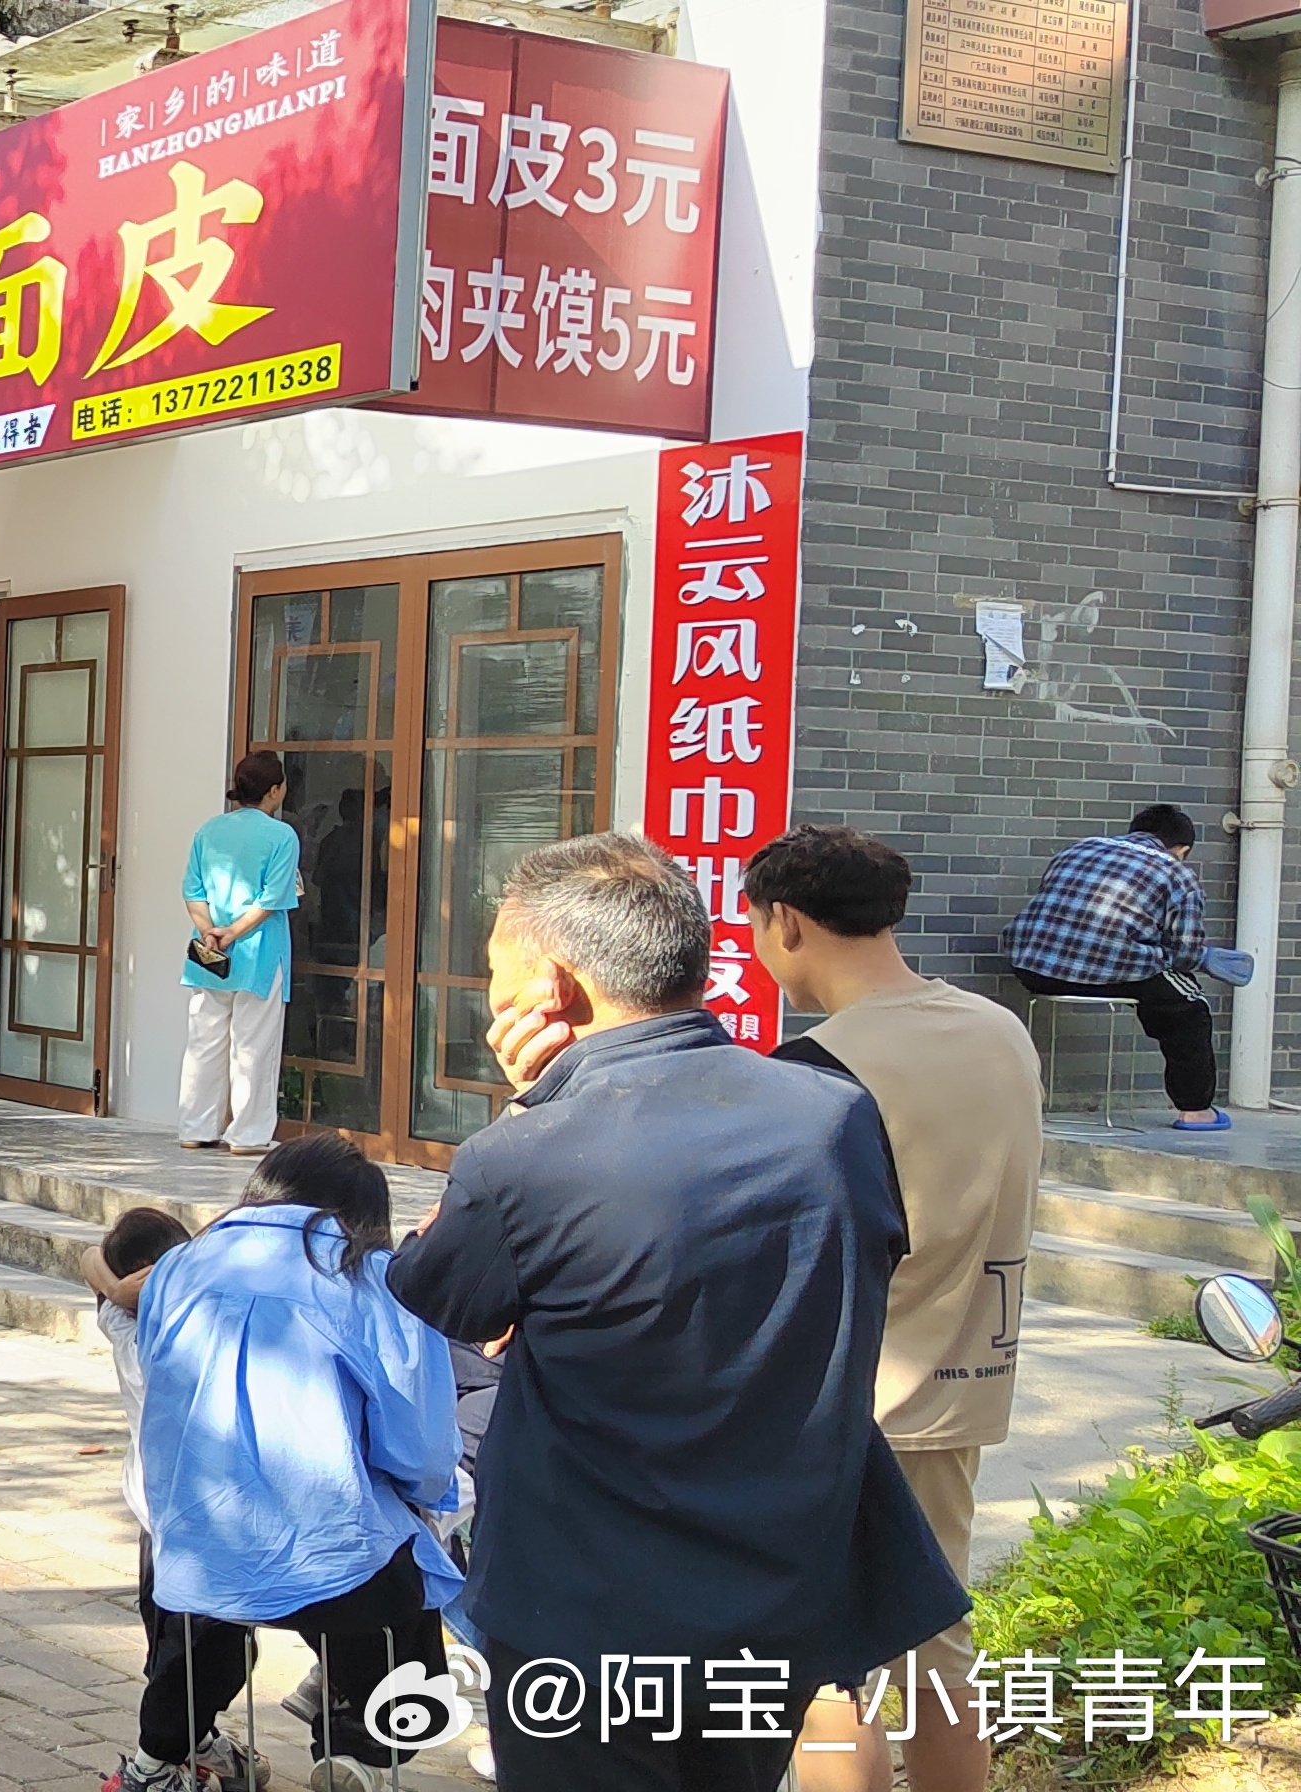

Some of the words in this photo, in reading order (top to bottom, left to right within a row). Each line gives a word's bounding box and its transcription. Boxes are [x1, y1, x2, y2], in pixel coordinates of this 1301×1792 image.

[97, 75, 347, 179] HANZHONGMIANPI
[113, 28, 345, 140] 家乡的味道
[428, 93, 701, 235] 面皮3元
[974, 1363, 1011, 1379] SHIRT
